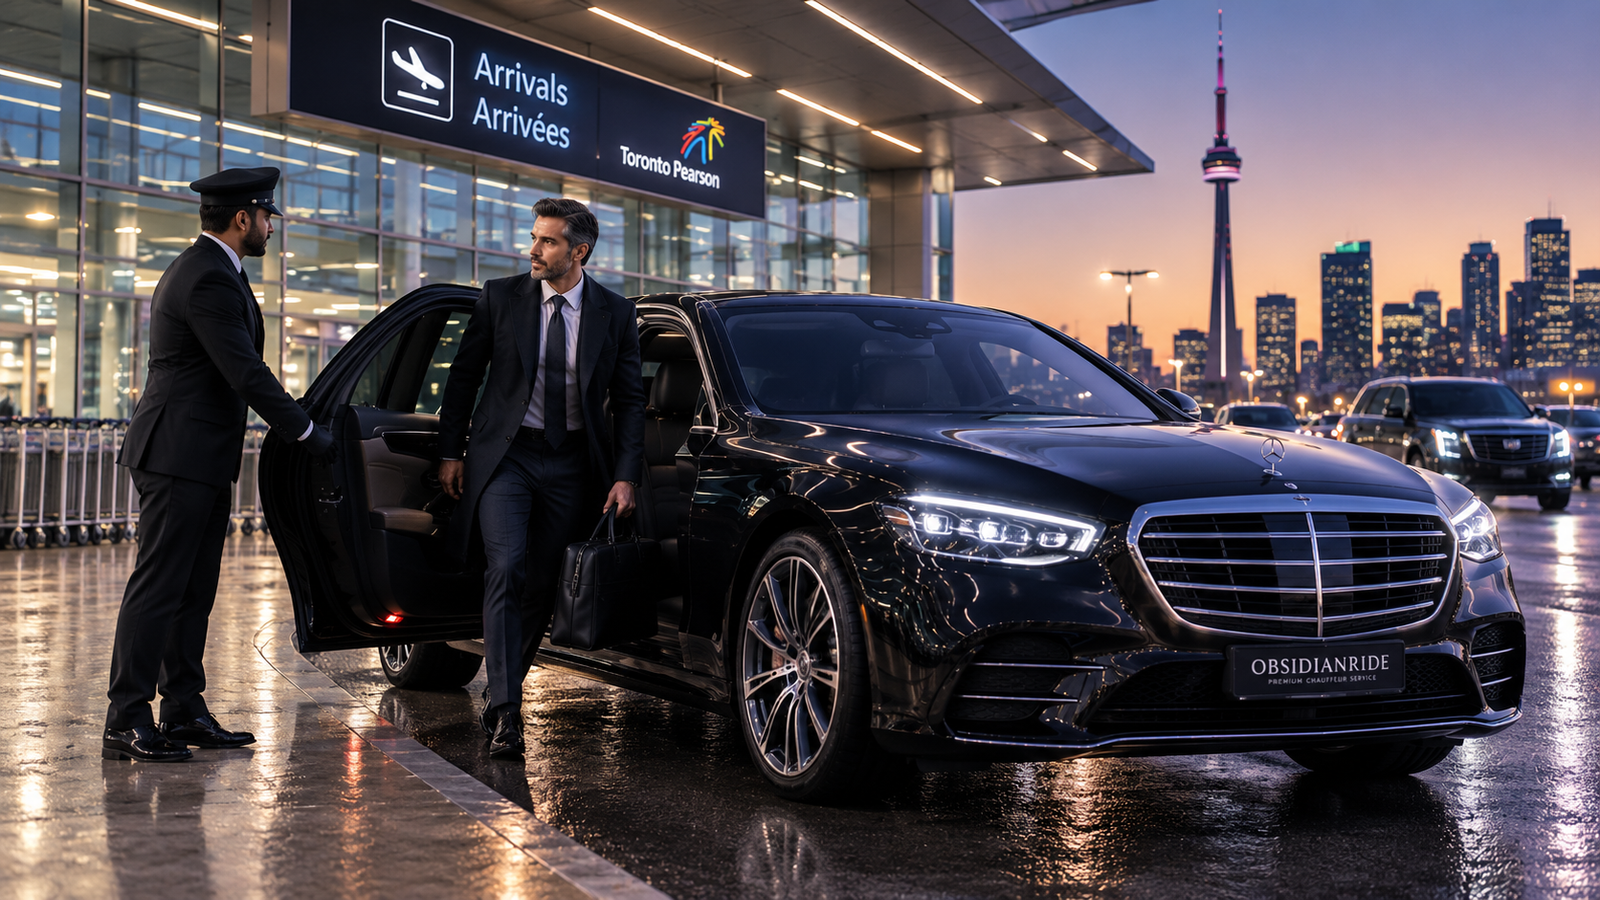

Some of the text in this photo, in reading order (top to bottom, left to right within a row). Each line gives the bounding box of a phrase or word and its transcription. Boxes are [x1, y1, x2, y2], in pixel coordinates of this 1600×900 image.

[474, 52, 568, 106] Arrivals
[472, 97, 570, 149] Arrivées
[620, 145, 720, 189] Toronto Pearson
[1251, 654, 1390, 675] OBSIDIANRIDE
[1306, 676, 1347, 684] CHAUFFEUR
